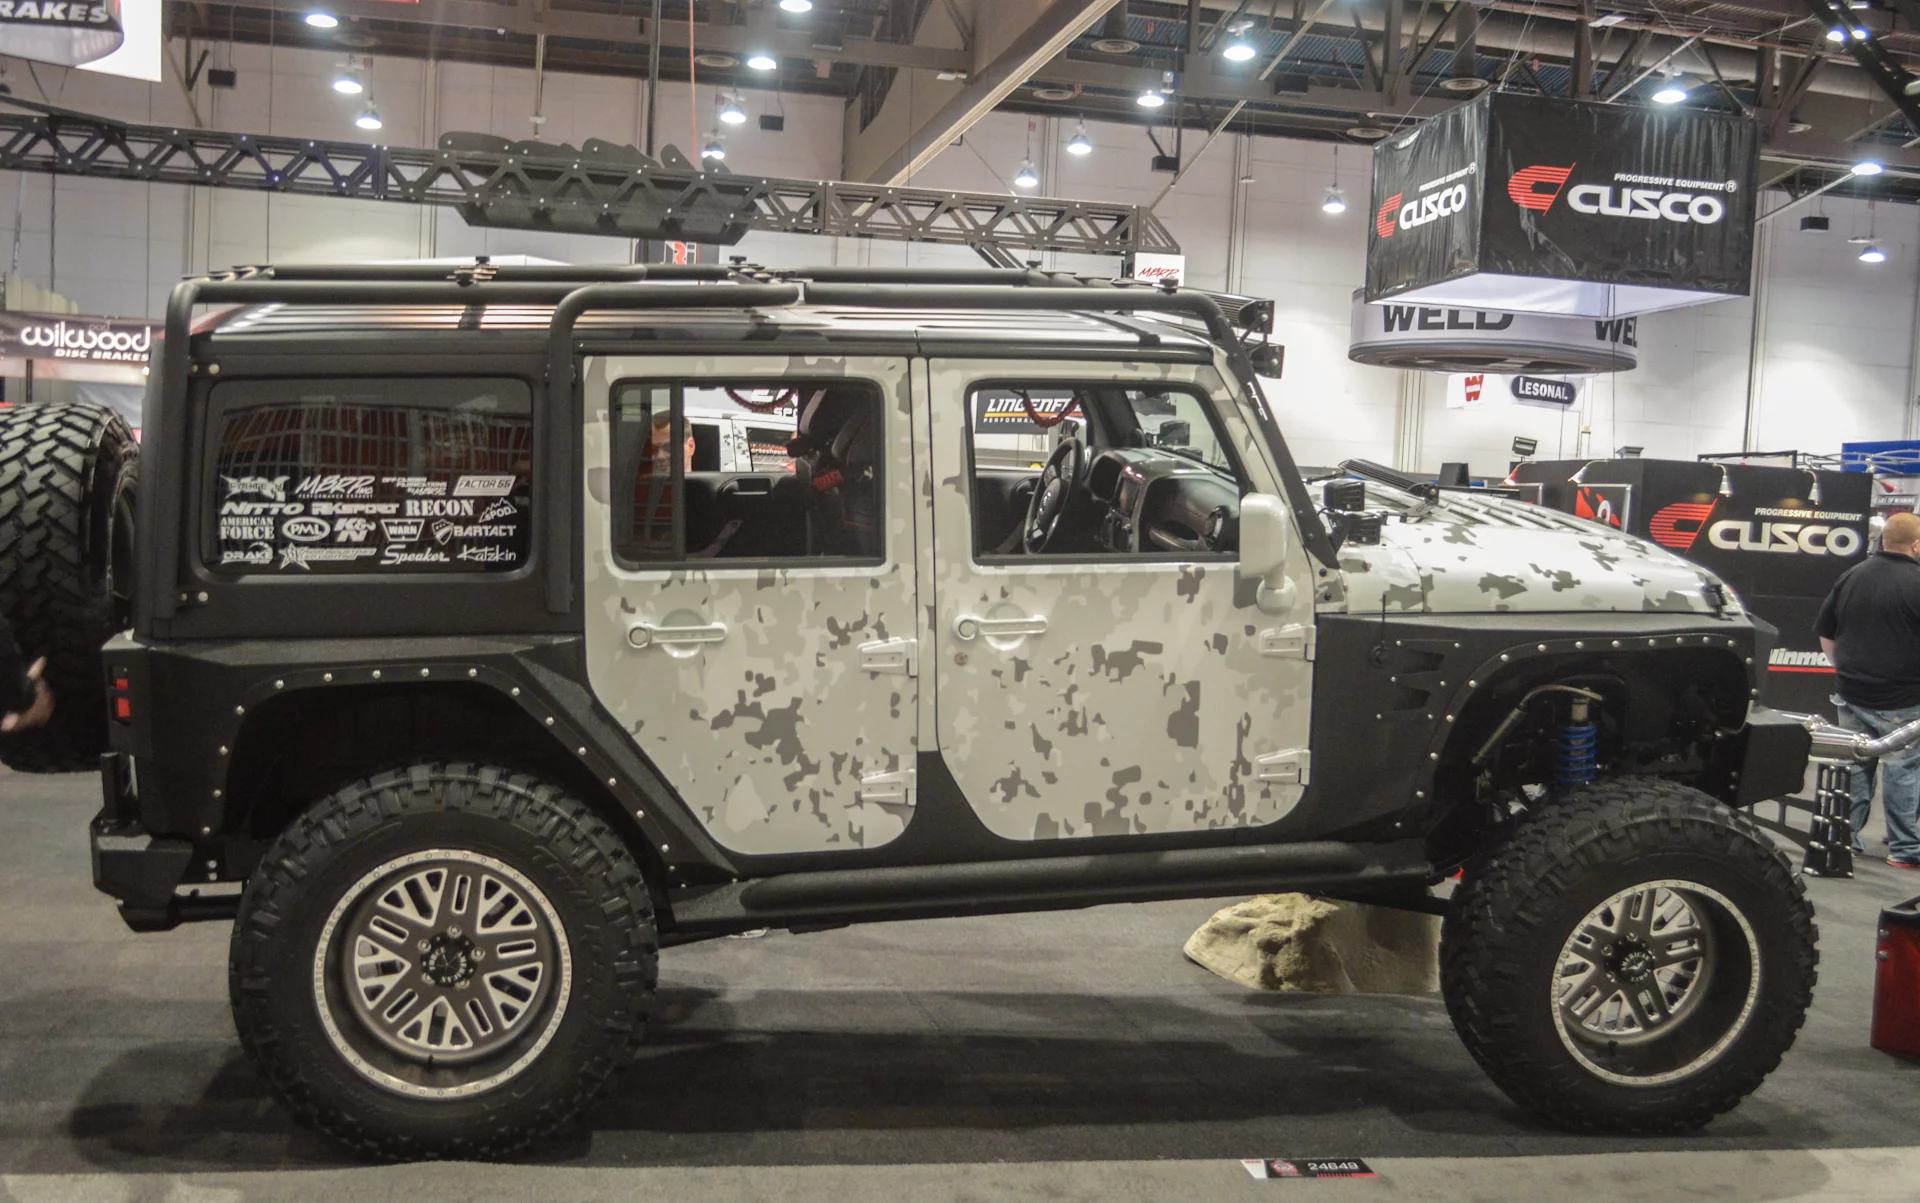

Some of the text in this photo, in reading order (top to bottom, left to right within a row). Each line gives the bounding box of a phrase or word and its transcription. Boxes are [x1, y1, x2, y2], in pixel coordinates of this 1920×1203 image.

[1614, 173, 1724, 191] PROGRESSIVE EQUIPMENT
[1399, 184, 1466, 230] CUSCO
[1567, 184, 1722, 224] CUSCO
[1383, 305, 1514, 333] WELD
[21, 321, 150, 352] wilwood
[54, 349, 149, 361] DISC BRAKES
[986, 398, 1082, 413] LINGENF
[459, 479, 496, 488] FACTOR
[221, 501, 304, 515] NITTO
[406, 500, 475, 516] RECON
[1755, 507, 1862, 521] PROGRESSIVE EQUIPMENT
[221, 517, 274, 526] AMERICAN
[220, 526, 275, 540] FORCE
[388, 525, 417, 535] WARN
[454, 525, 516, 537] BARTACT
[1708, 519, 1859, 556] CUSCO
[380, 544, 450, 565] Speaker
[457, 545, 516, 562] Katzkin
